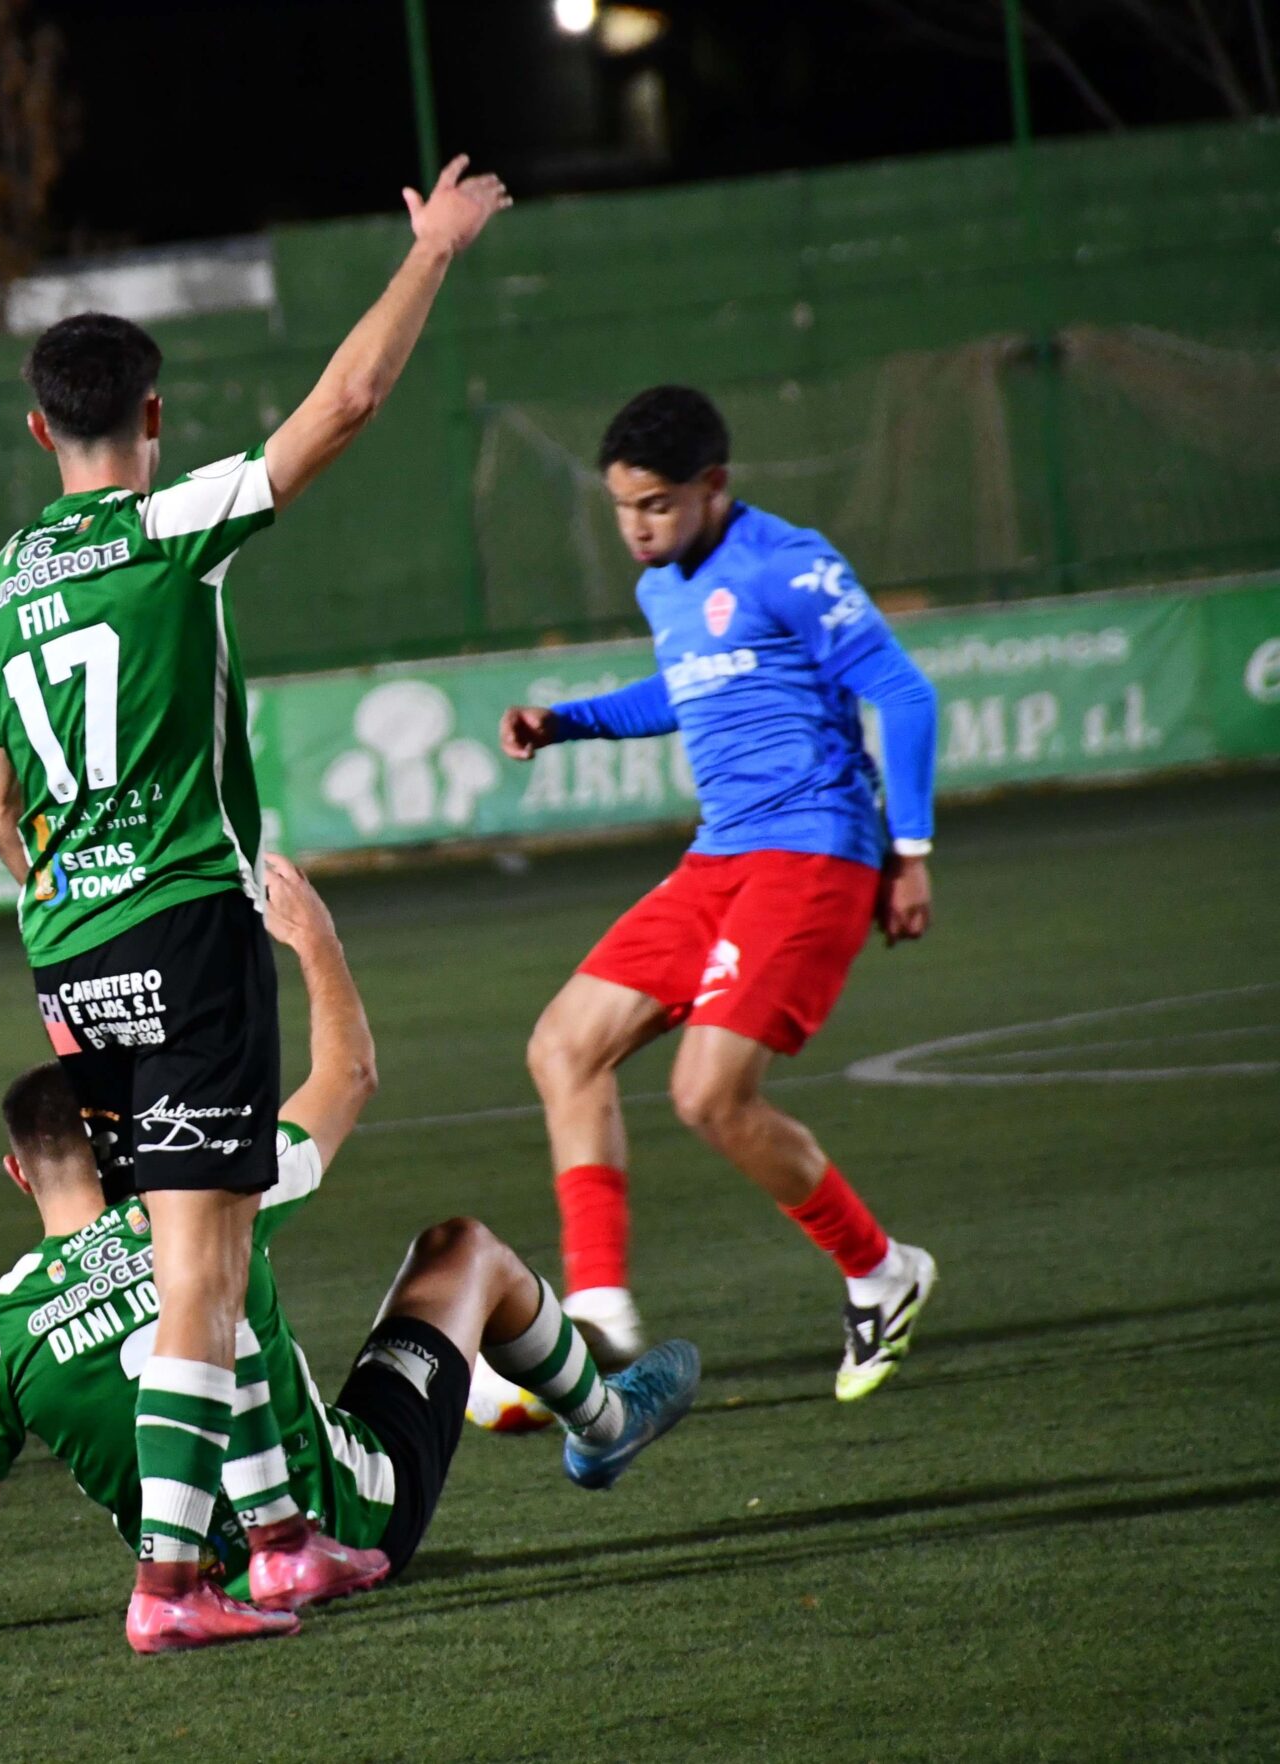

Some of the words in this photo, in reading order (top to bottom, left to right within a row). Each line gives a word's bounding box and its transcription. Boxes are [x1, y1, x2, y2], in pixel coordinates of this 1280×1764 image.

[17, 591, 70, 640] FITA
[2, 622, 119, 804] 17
[62, 842, 136, 871] SETAS
[69, 866, 147, 900] TOMÁS
[59, 969, 162, 1005] CARRETERO
[68, 1005, 84, 1025] E
[132, 1094, 253, 1120] Autocares
[137, 1116, 253, 1155] Diego
[68, 1209, 122, 1251] UCLM
[81, 1236, 129, 1275] GC
[47, 1301, 125, 1364] DANI
